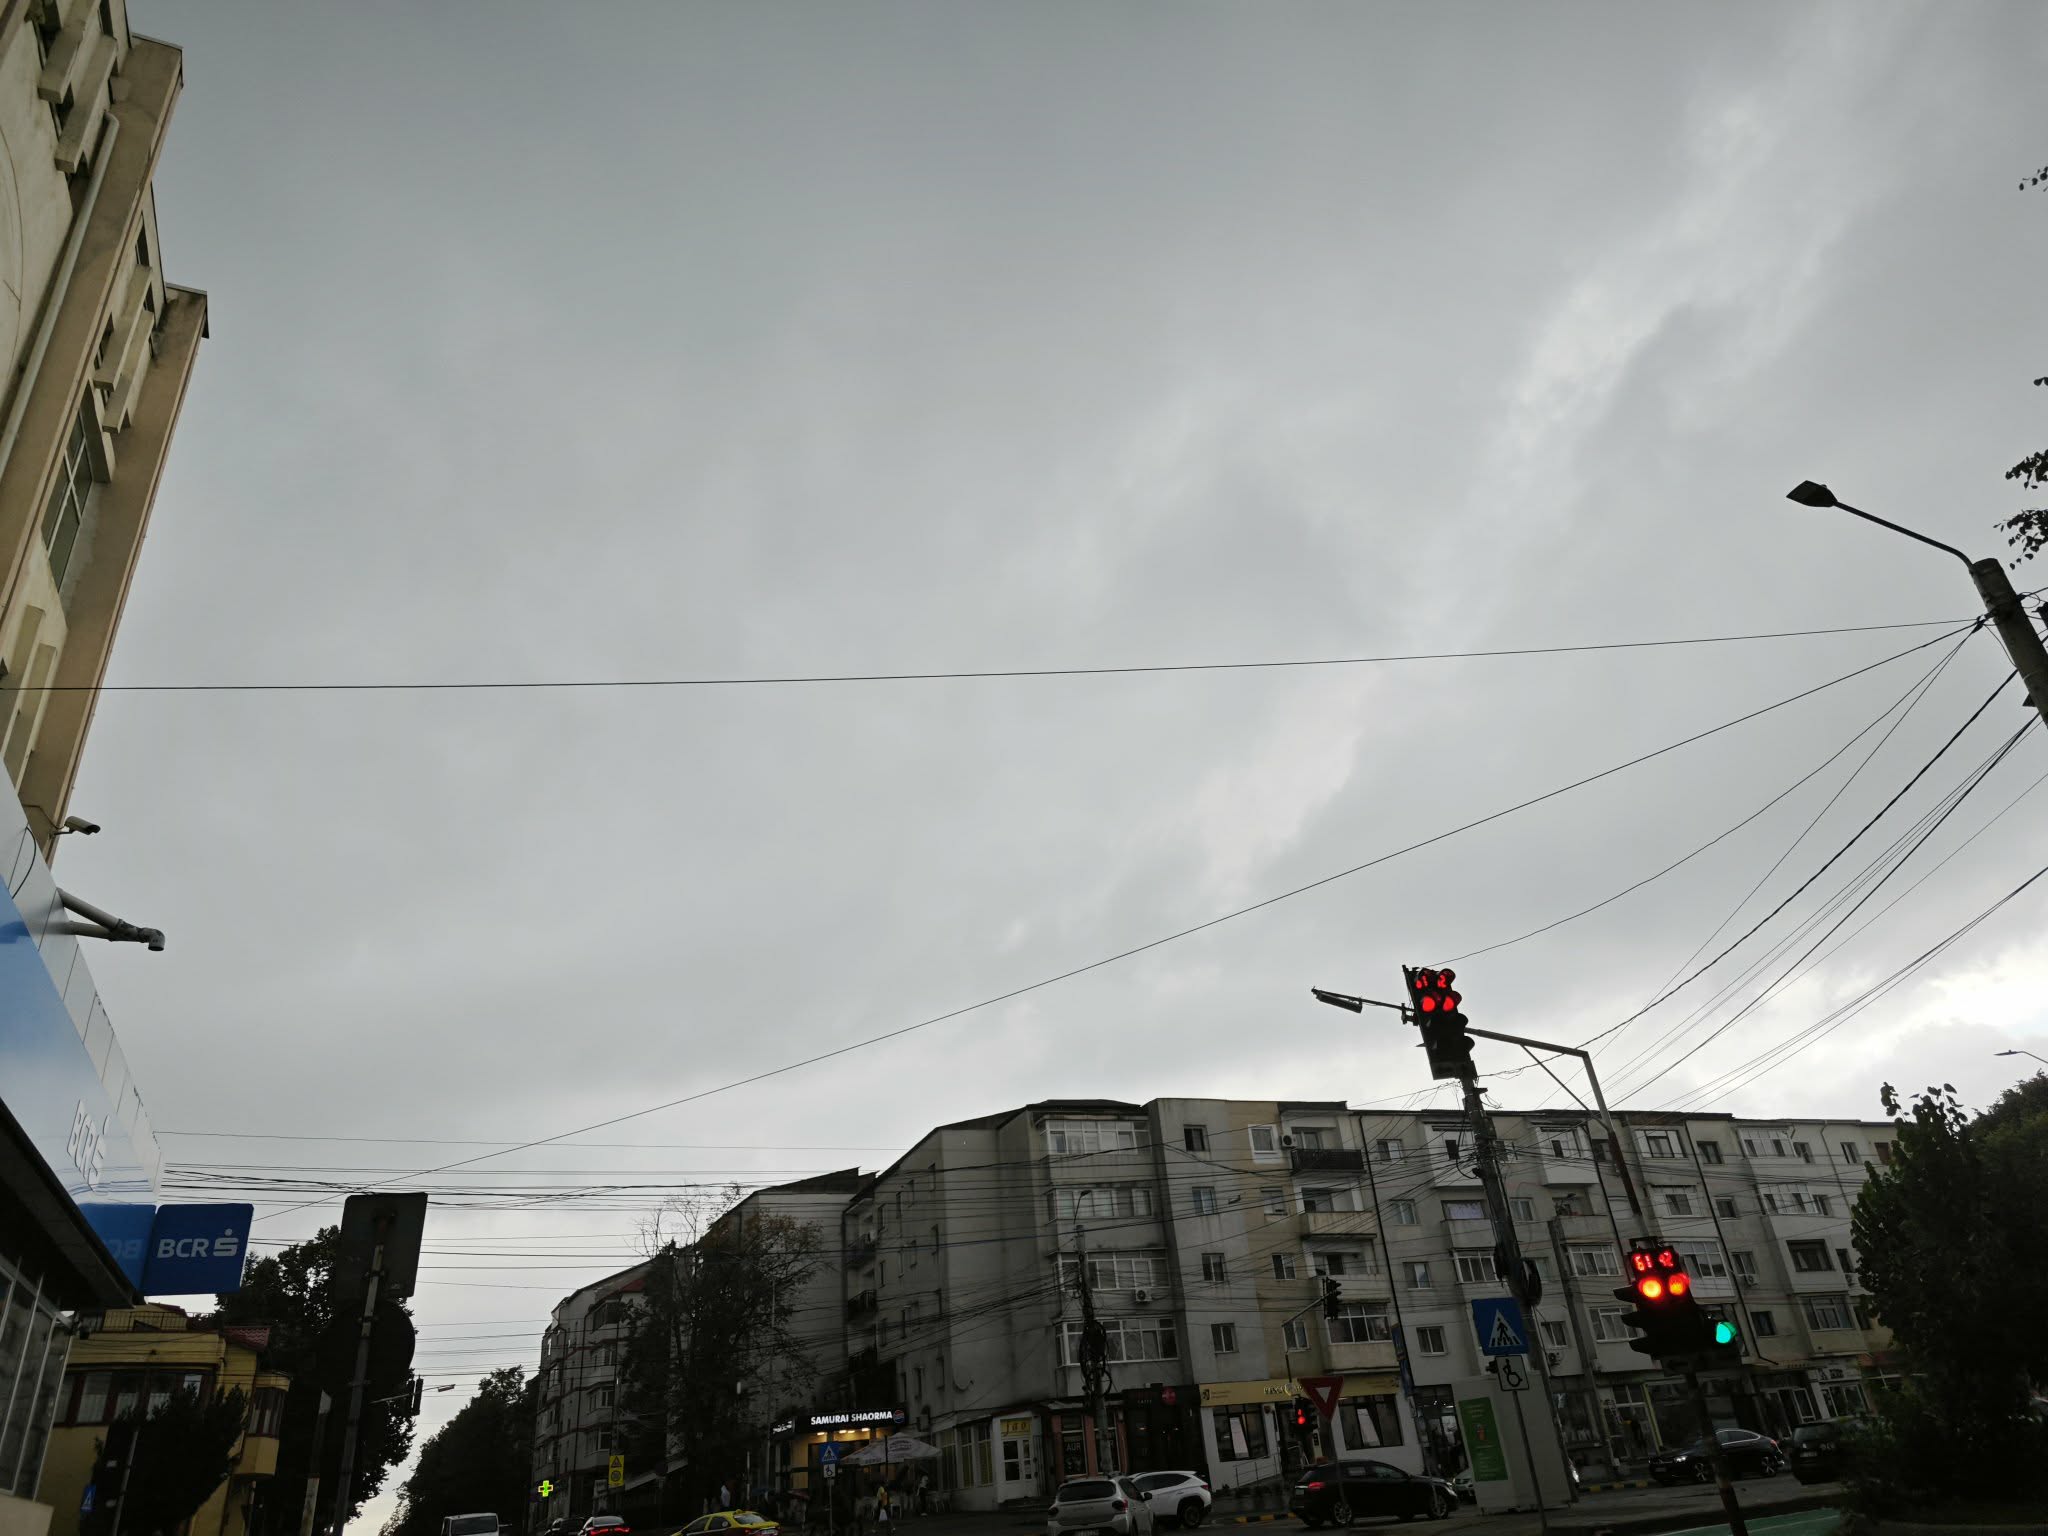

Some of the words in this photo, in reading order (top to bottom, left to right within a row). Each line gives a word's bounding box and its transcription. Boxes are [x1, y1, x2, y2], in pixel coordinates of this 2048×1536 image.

[157, 1238, 209, 1258] BCR
[810, 1414, 849, 1426] SAMURAI
[851, 1410, 893, 1423] SHAORMA
